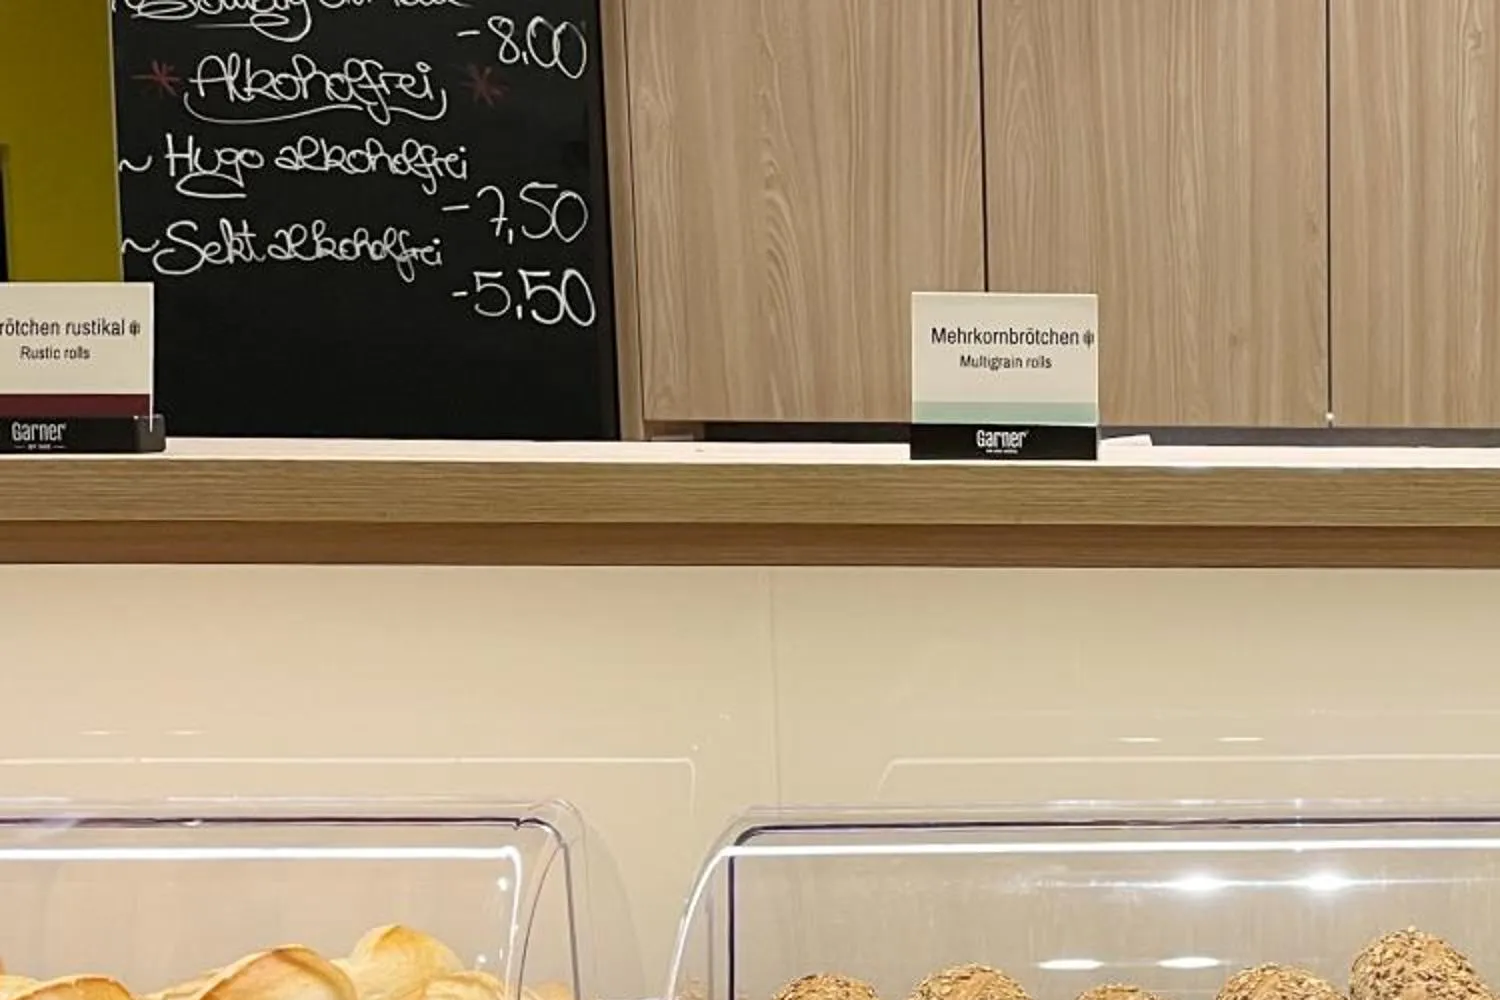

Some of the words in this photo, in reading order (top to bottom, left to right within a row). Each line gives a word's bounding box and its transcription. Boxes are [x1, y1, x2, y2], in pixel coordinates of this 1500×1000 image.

[189, 52, 434, 125] Alkoholfrei
[164, 132, 265, 198] Hugo
[274, 135, 468, 195] alkoholfrei
[153, 218, 266, 275] Sekt
[267, 219, 443, 283] alkoholfrei
[0, 317, 60, 336] rötchen
[65, 318, 125, 336] rustikal
[930, 327, 1080, 346] Mehrkornbrötchen
[19, 345, 61, 360] Rustic
[63, 345, 91, 360] rolls
[959, 355, 1023, 371] Multigrain
[1026, 355, 1053, 369] rolls
[11, 421, 67, 441] Garner
[976, 429, 1028, 448] Garner
